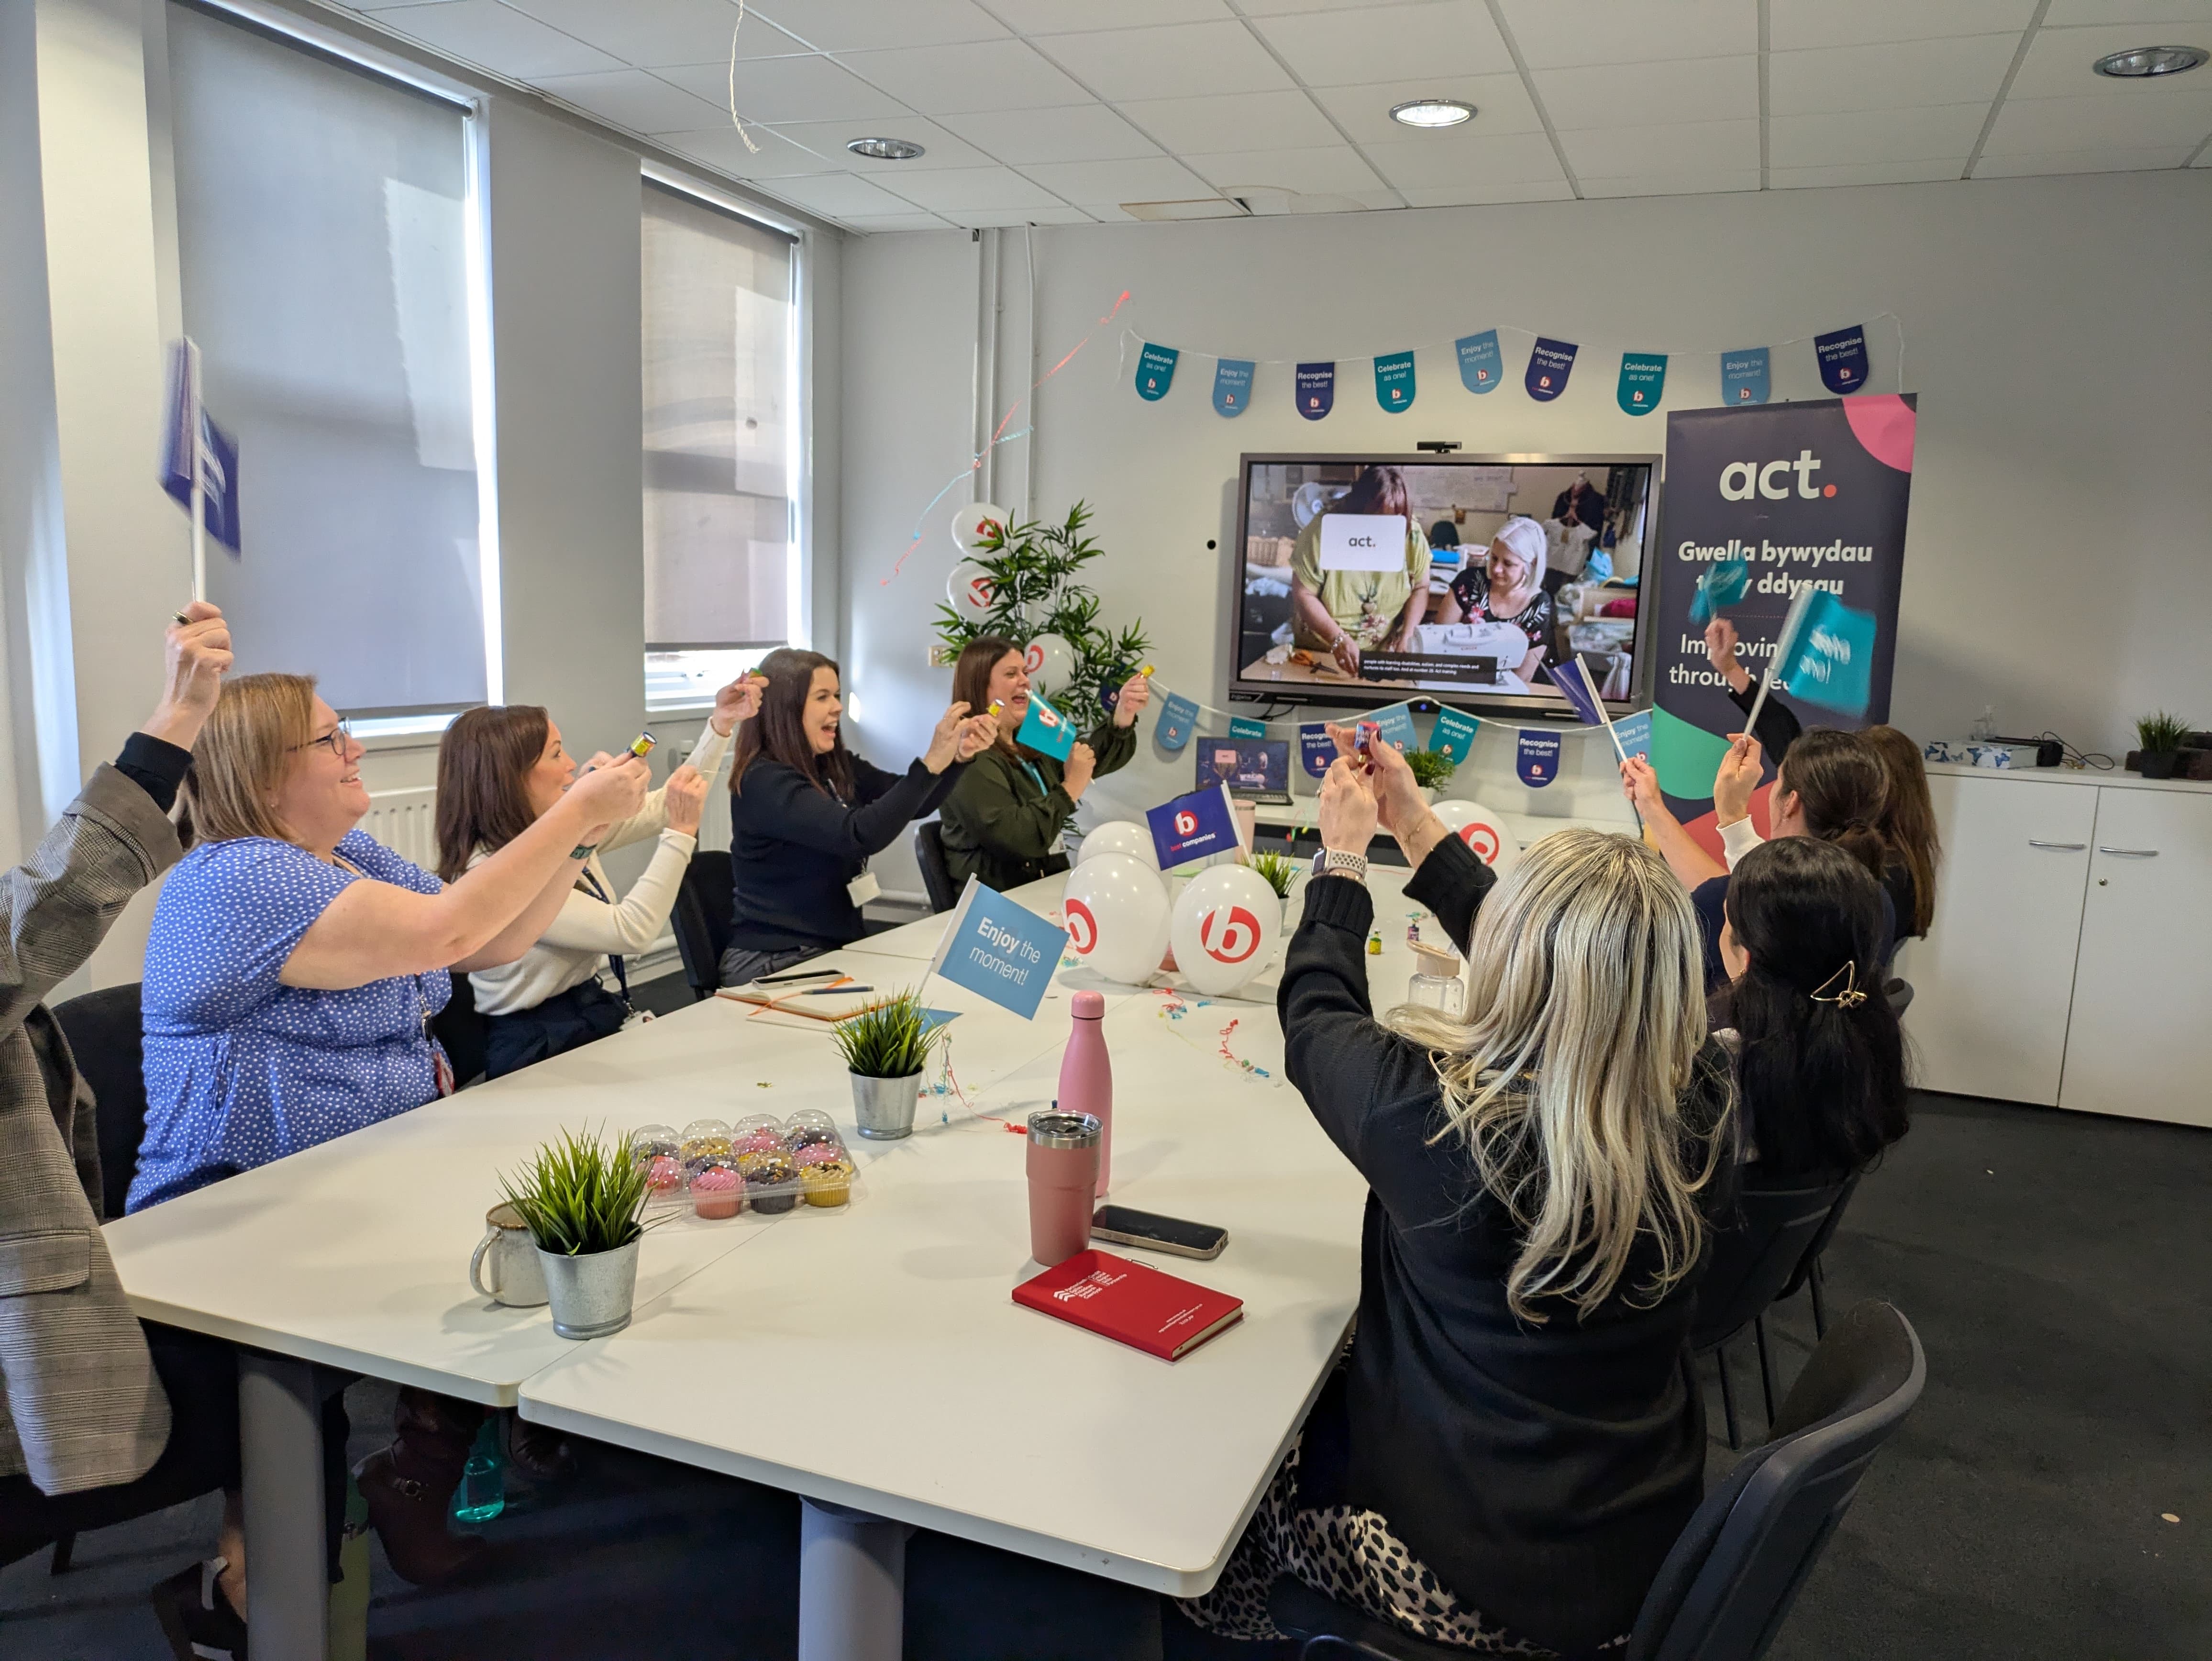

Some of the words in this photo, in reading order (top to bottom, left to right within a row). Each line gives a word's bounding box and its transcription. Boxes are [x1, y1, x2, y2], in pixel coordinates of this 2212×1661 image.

[1461, 344, 1481, 355] Enjoy
[1482, 342, 1494, 350] the
[1818, 337, 1862, 353] Recognise
[1144, 352, 1173, 365] Celebrate
[1464, 350, 1493, 364] moment!
[1535, 346, 1573, 362] Recognise
[1825, 354, 1837, 362] the
[1839, 348, 1858, 358] best!
[1377, 361, 1411, 373] Celebrate
[1537, 357, 1548, 366] the
[1548, 359, 1565, 370] best!
[1625, 363, 1662, 372] Celebrate
[1726, 362, 1749, 370] Enjoy
[1220, 368, 1238, 377] Enjoy
[1298, 371, 1332, 380] Recognise
[1719, 450, 1837, 501] act.
[1349, 536, 1376, 548] act.
[1678, 540, 1755, 562] Gwella
[1761, 539, 1873, 568] bywydau
[1440, 716, 1474, 733] Celebrate
[1232, 725, 1262, 738] Celebrate
[1519, 738, 1559, 748] Recognise
[1170, 843, 1182, 852] best
[1182, 833, 1216, 848] companies
[977, 917, 1020, 953] Enjoy
[1020, 941, 1041, 963] the
[969, 946, 1029, 986] moment!
